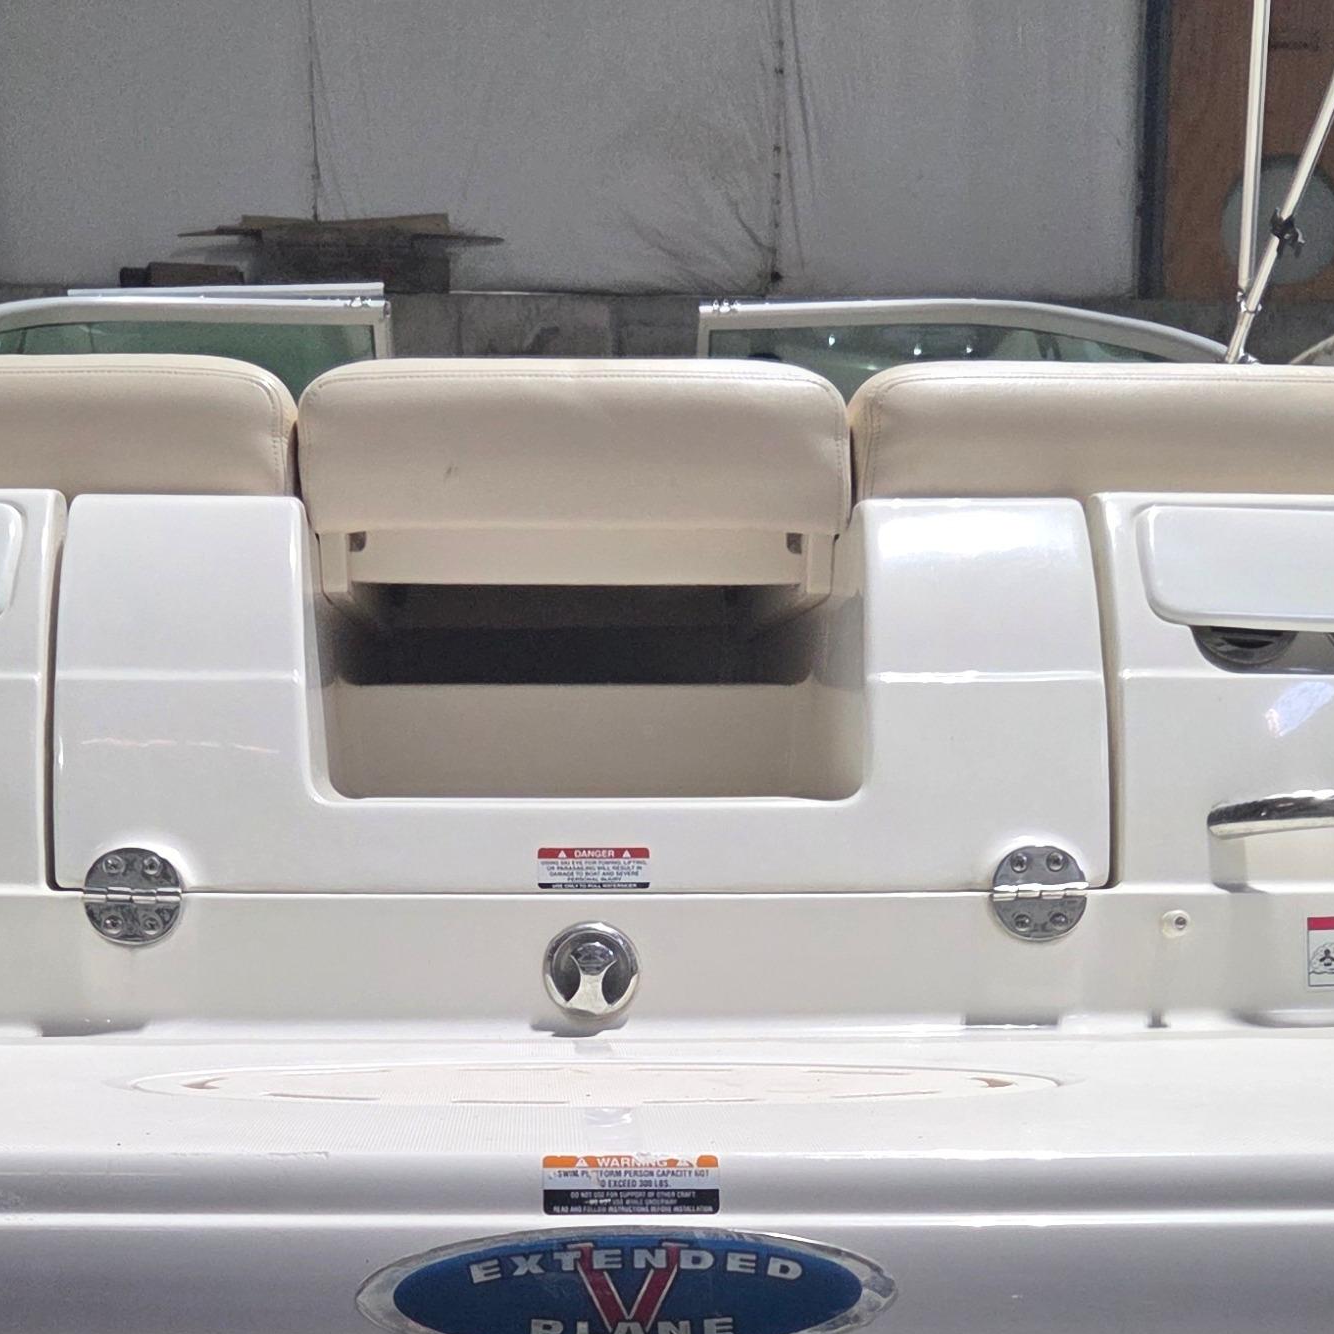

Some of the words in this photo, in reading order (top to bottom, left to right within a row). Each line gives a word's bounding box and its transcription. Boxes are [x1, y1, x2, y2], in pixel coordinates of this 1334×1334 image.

[574, 850, 615, 858] DANGER
[596, 1157, 668, 1168] WARNING
[624, 1170, 655, 1178] PERSON
[656, 1170, 692, 1178] CAPACITY
[694, 1170, 709, 1178] NOT
[606, 1179, 637, 1188] EXCEED
[639, 1179, 653, 1188] 300
[654, 1179, 672, 1188] LBS.
[469, 1248, 804, 1284] EXTENDED
